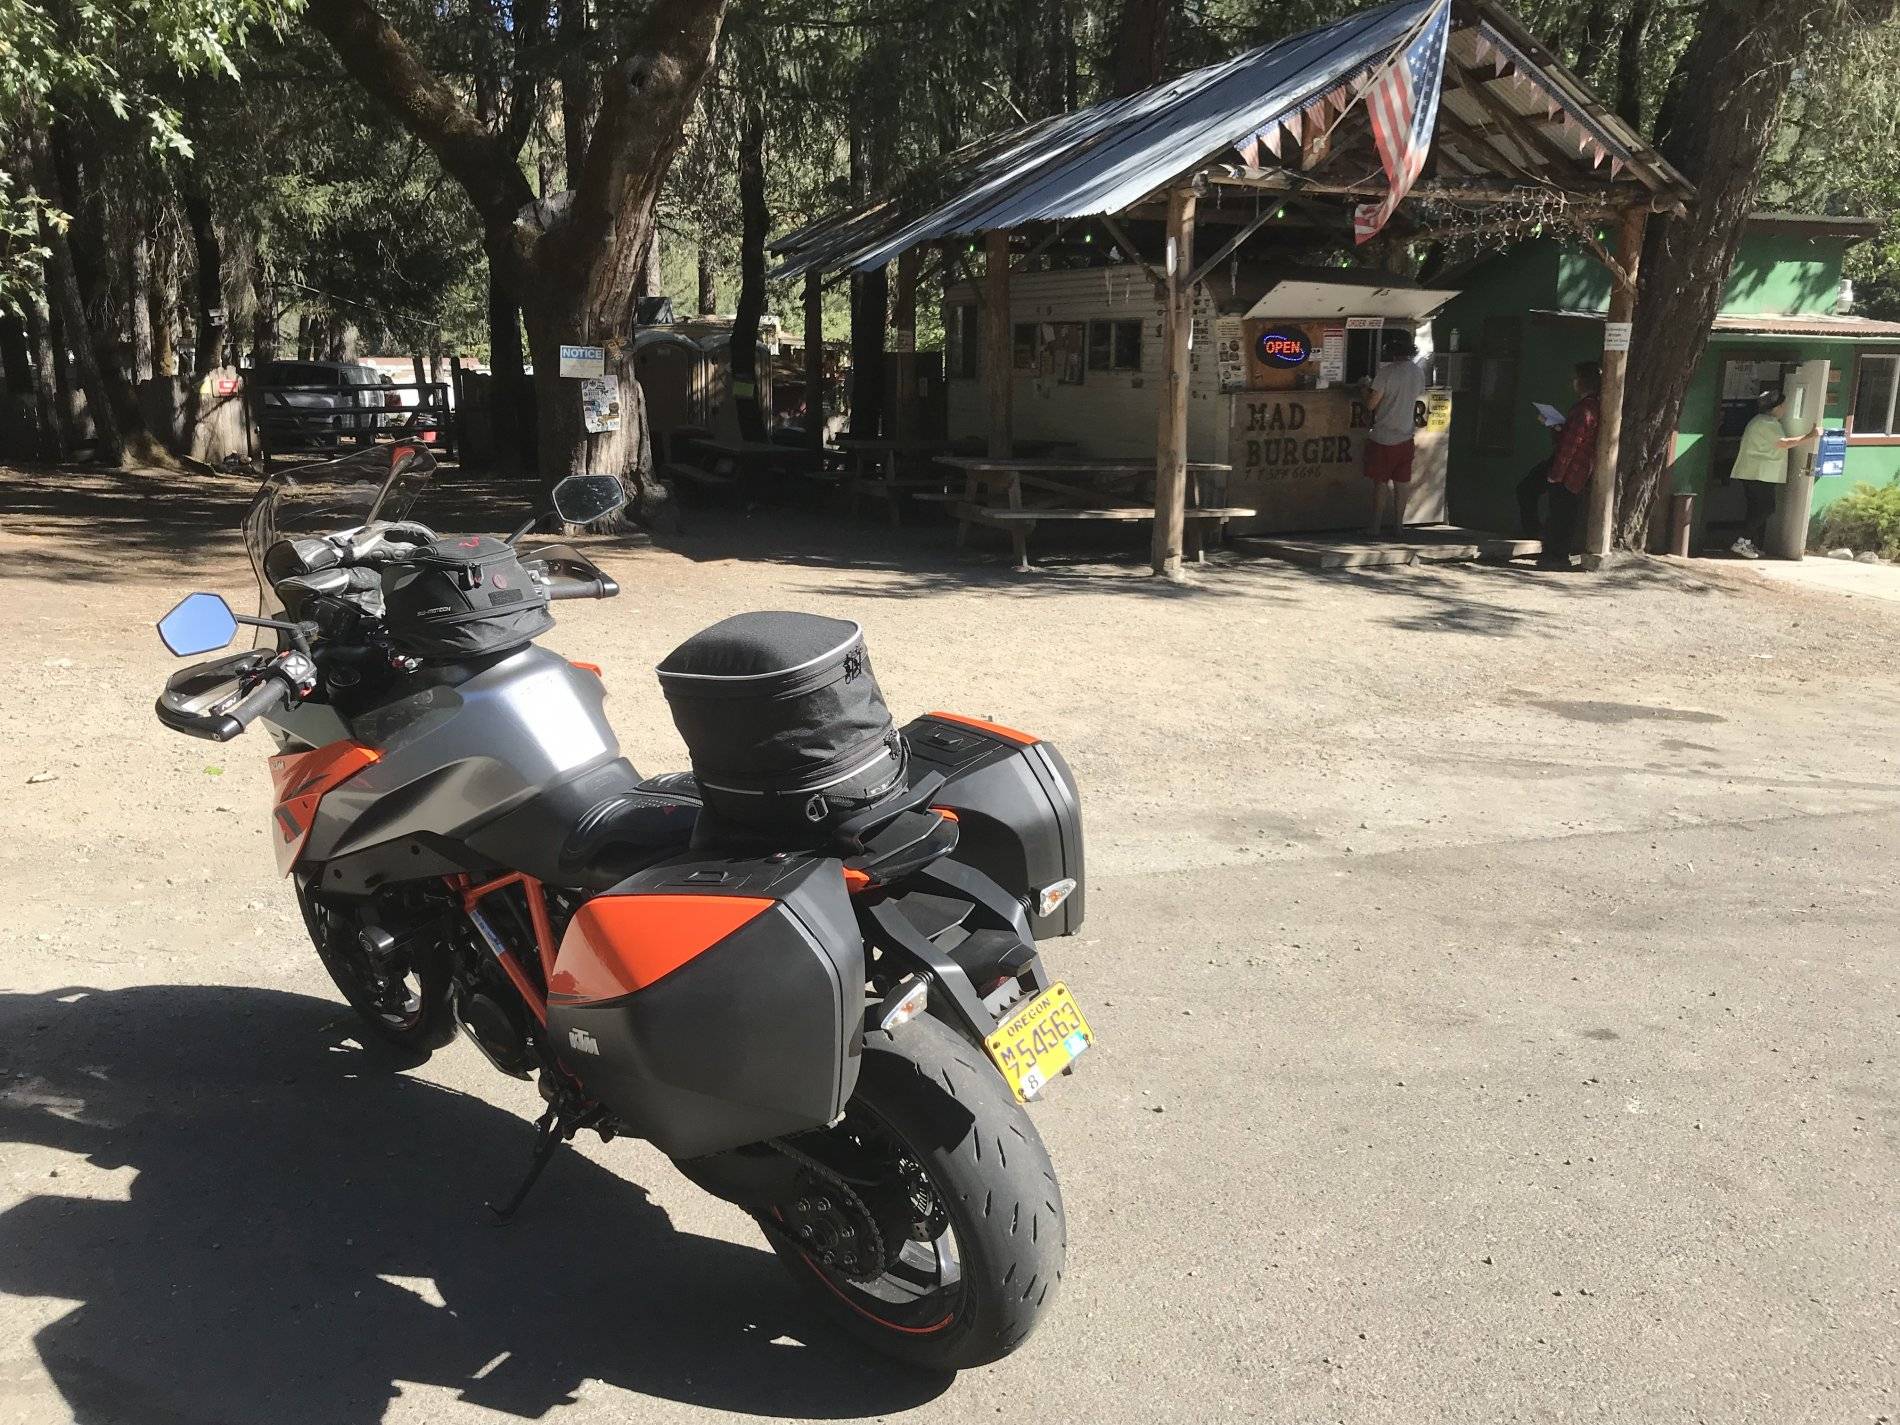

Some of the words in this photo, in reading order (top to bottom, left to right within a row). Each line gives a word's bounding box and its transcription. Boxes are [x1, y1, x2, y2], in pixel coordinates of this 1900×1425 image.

[562, 347, 603, 359] NOTICE
[1266, 341, 1301, 354] OPEN
[1246, 402, 1306, 431] MAD
[1246, 435, 1353, 467] BURGER
[1007, 998, 1051, 1037] OREGON
[568, 1027, 600, 1056] KTM
[1027, 1075, 1039, 1089] 8
